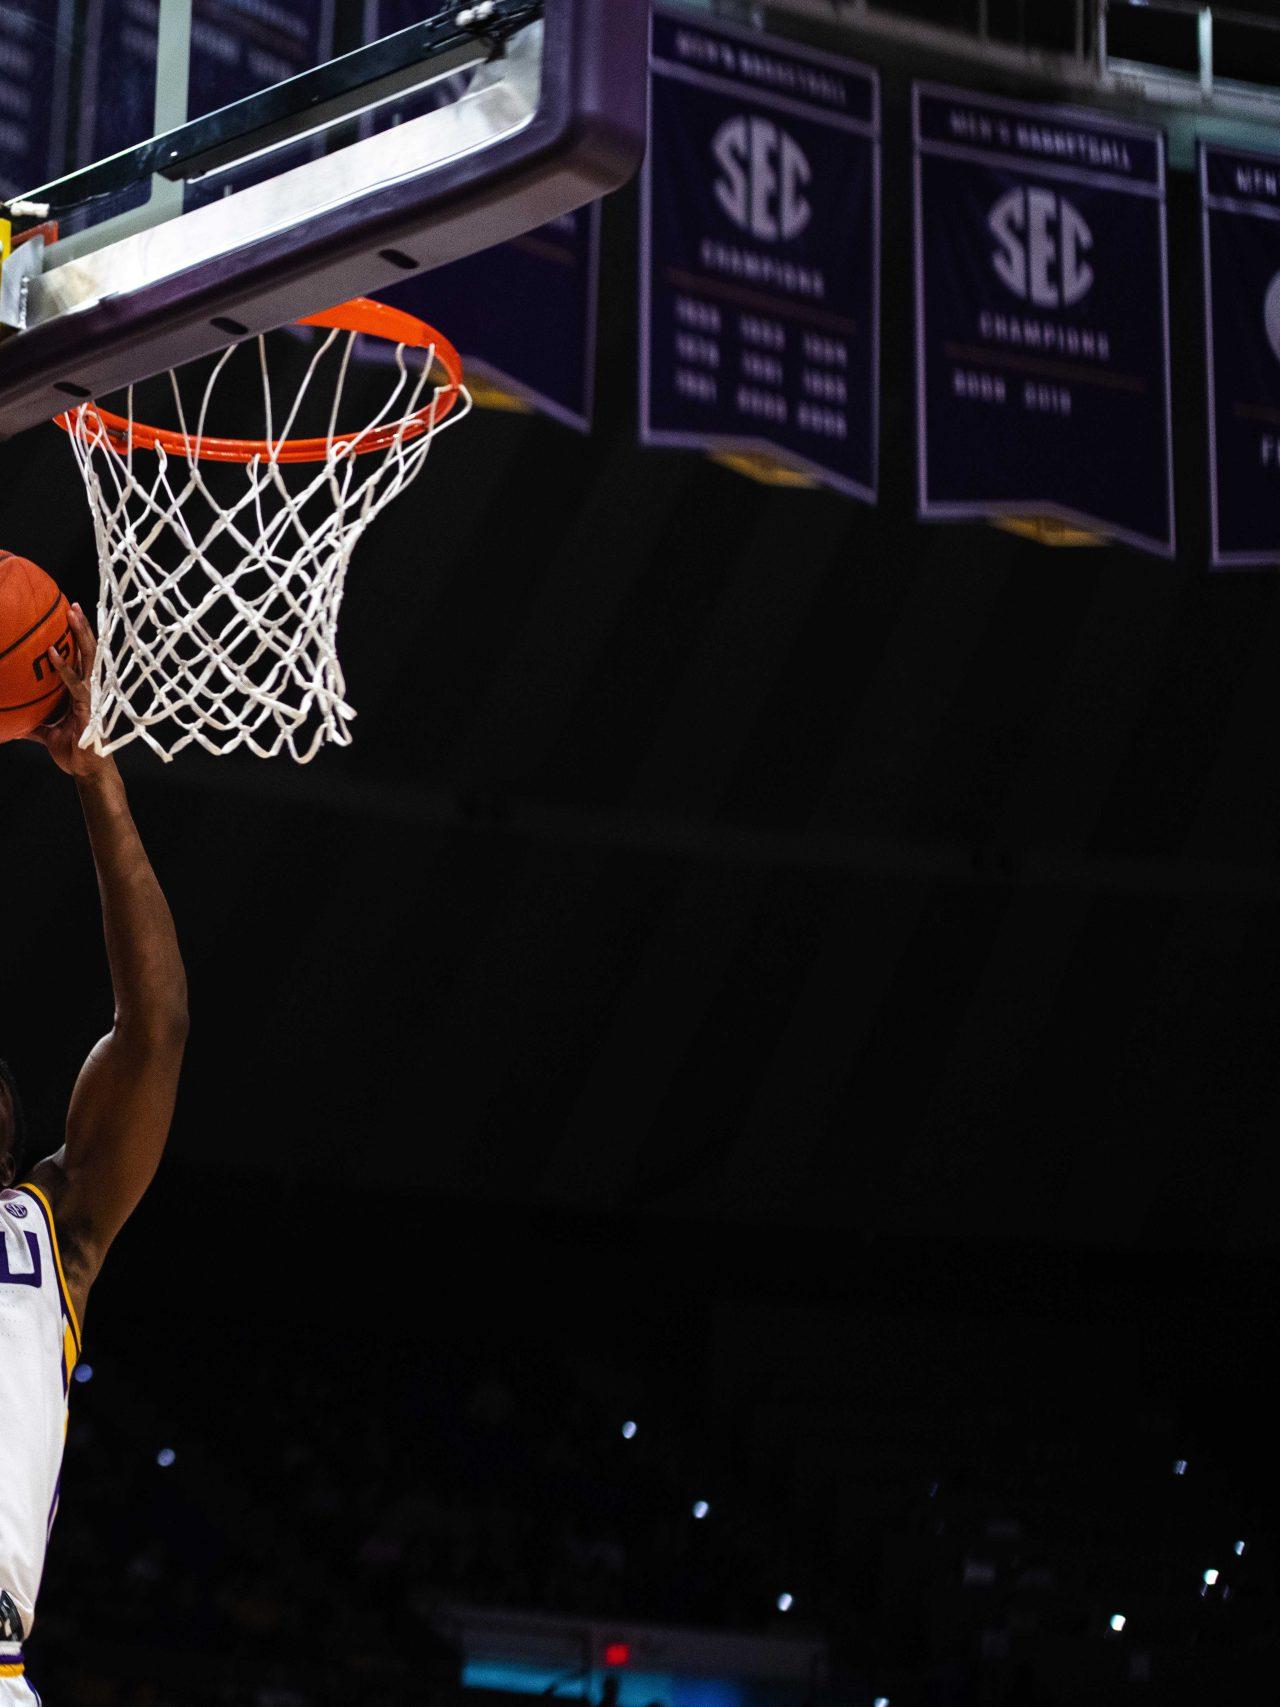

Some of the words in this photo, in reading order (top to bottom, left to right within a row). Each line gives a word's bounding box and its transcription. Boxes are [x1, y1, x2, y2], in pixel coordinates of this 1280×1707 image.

[711, 113, 812, 243] SEC
[987, 185, 1095, 310] SEC
[978, 310, 1111, 362] CHAMPIONS
